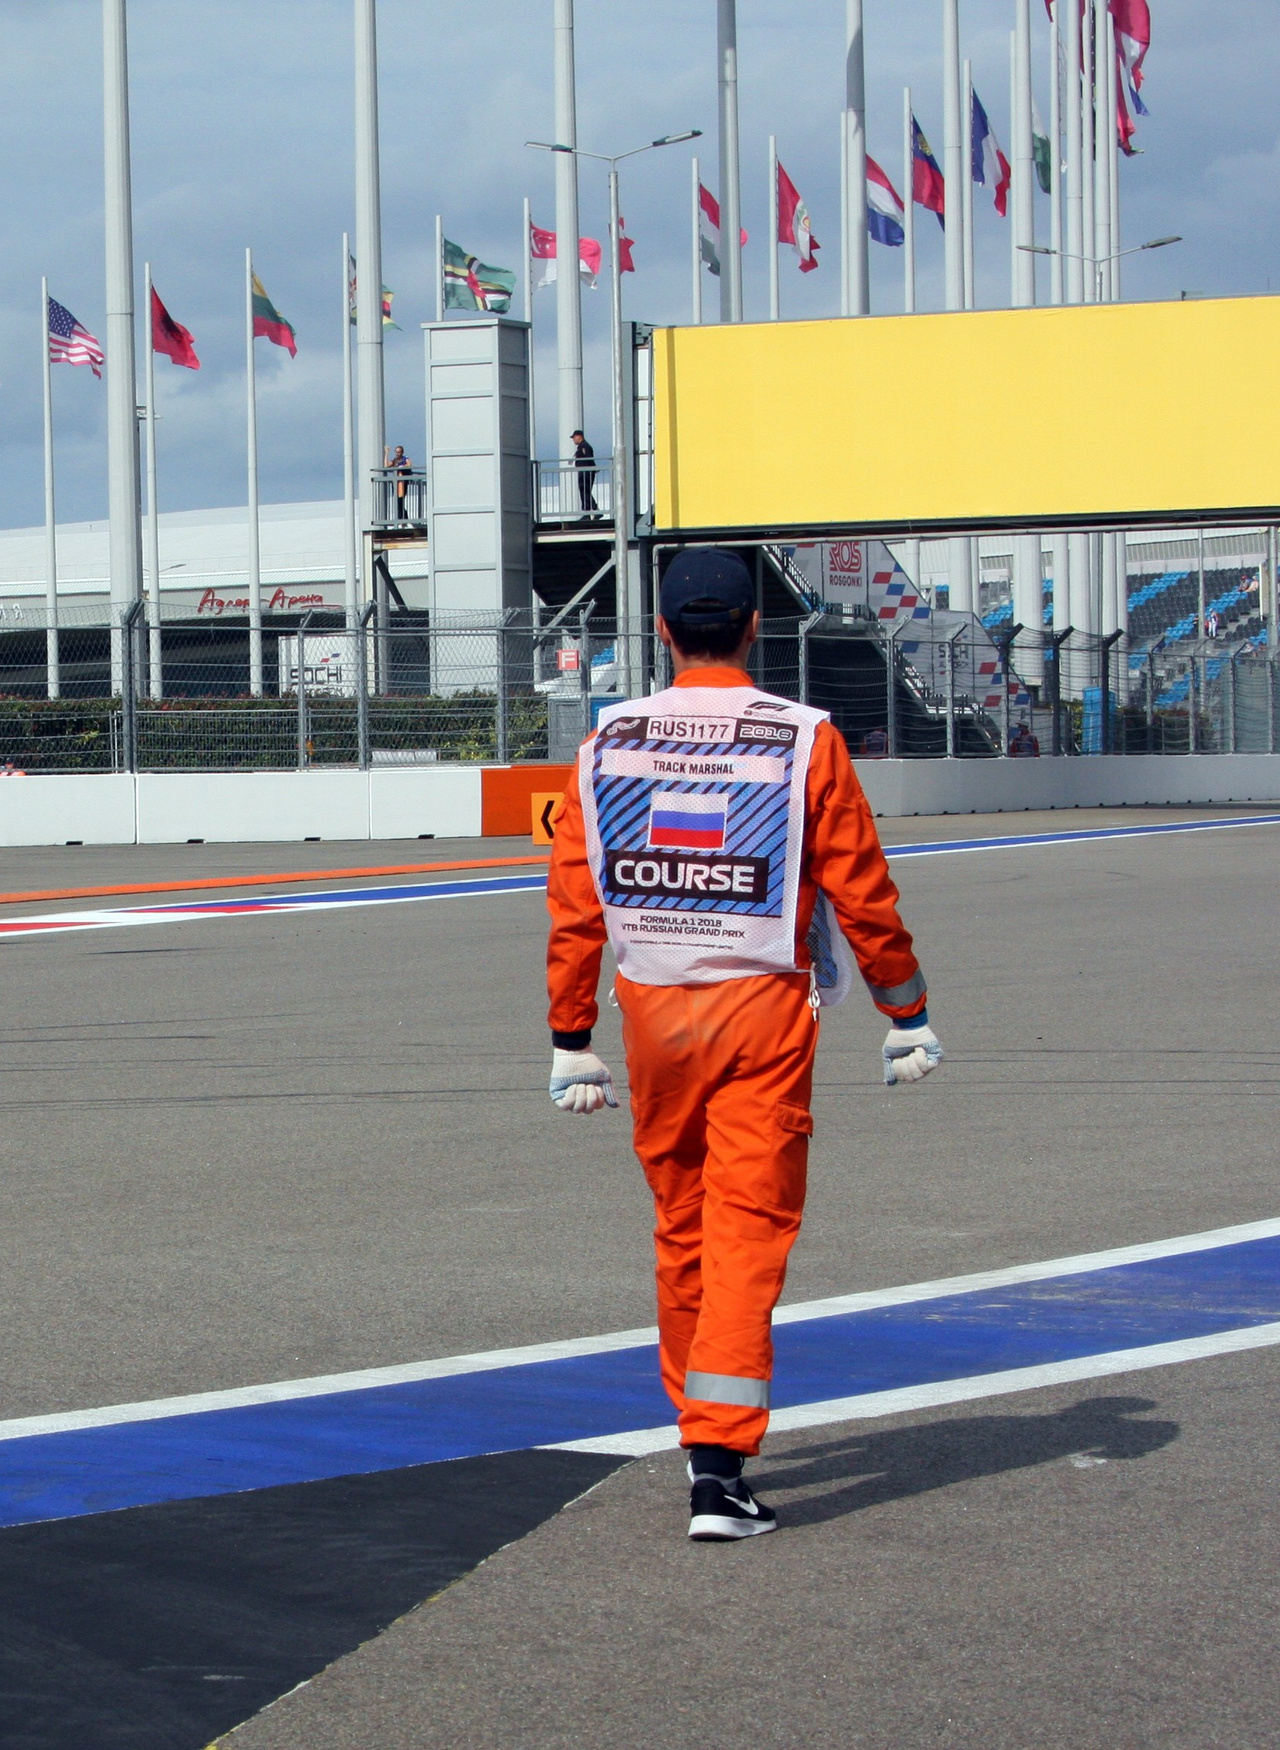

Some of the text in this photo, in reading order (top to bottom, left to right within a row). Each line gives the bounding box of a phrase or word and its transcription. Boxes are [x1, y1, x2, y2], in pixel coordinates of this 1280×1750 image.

[829, 574, 862, 587] ROSGONKI
[562, 652, 576, 668] F
[649, 720, 729, 739] RUS1177
[740, 724, 793, 741] 2018
[653, 760, 734, 775] TRACK MARSHAL
[614, 859, 755, 893] COURSE
[640, 915, 722, 927] FORMULA 1 2018
[621, 923, 746, 938] VTB RUSSIAN GRAND PRIX
